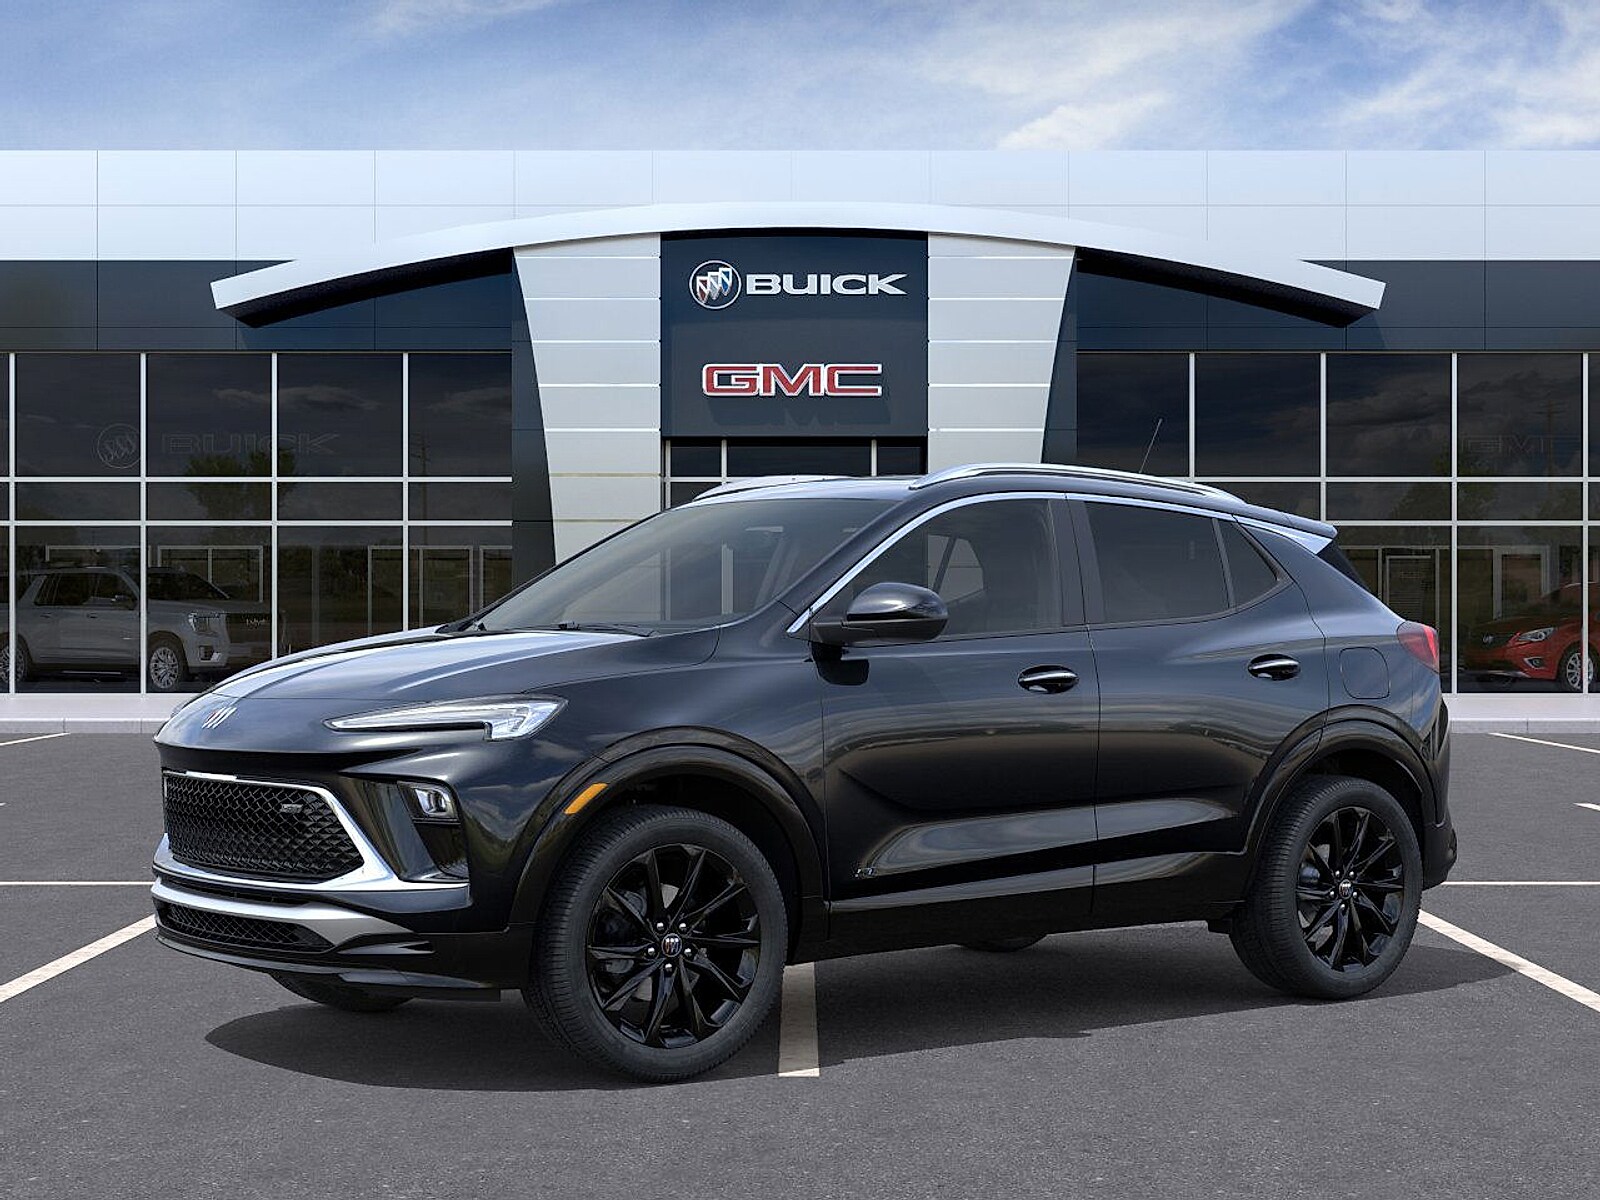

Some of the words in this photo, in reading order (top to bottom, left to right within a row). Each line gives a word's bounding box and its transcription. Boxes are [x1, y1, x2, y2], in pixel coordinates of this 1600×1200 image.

[746, 273, 908, 295] BUICK
[702, 363, 882, 396] GMC
[160, 431, 340, 455] BUICK
